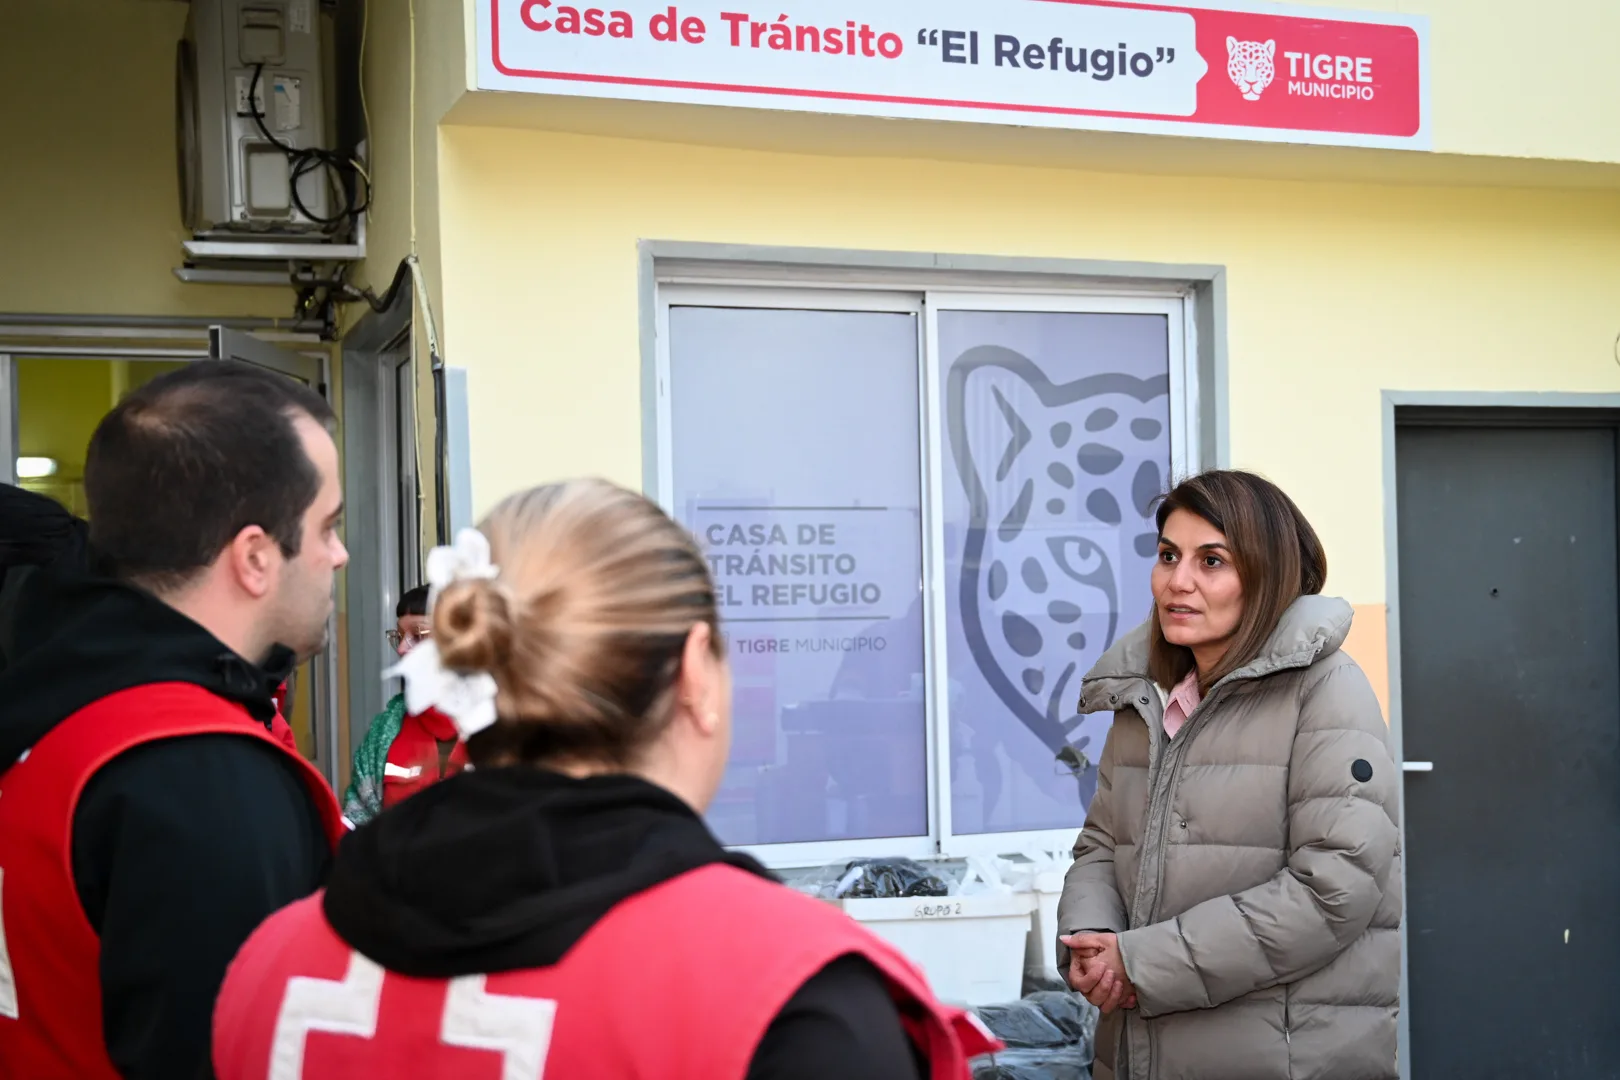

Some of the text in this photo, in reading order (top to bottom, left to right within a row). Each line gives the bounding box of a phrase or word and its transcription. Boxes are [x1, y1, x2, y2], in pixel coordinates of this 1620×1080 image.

[519, 0, 633, 39] Casa
[648, 6, 706, 44] de
[720, 12, 904, 59] Tránsito
[1283, 51, 1374, 83] TIGRE
[1287, 81, 1375, 101] MUNICIPIO
[705, 523, 836, 546] CASA DE
[706, 548, 857, 576] TRÁNSITO
[751, 582, 882, 606] REFUGIO
[736, 636, 888, 654] TIGRE MUNICIPIO
[914, 902, 962, 919] GRUPO 2
